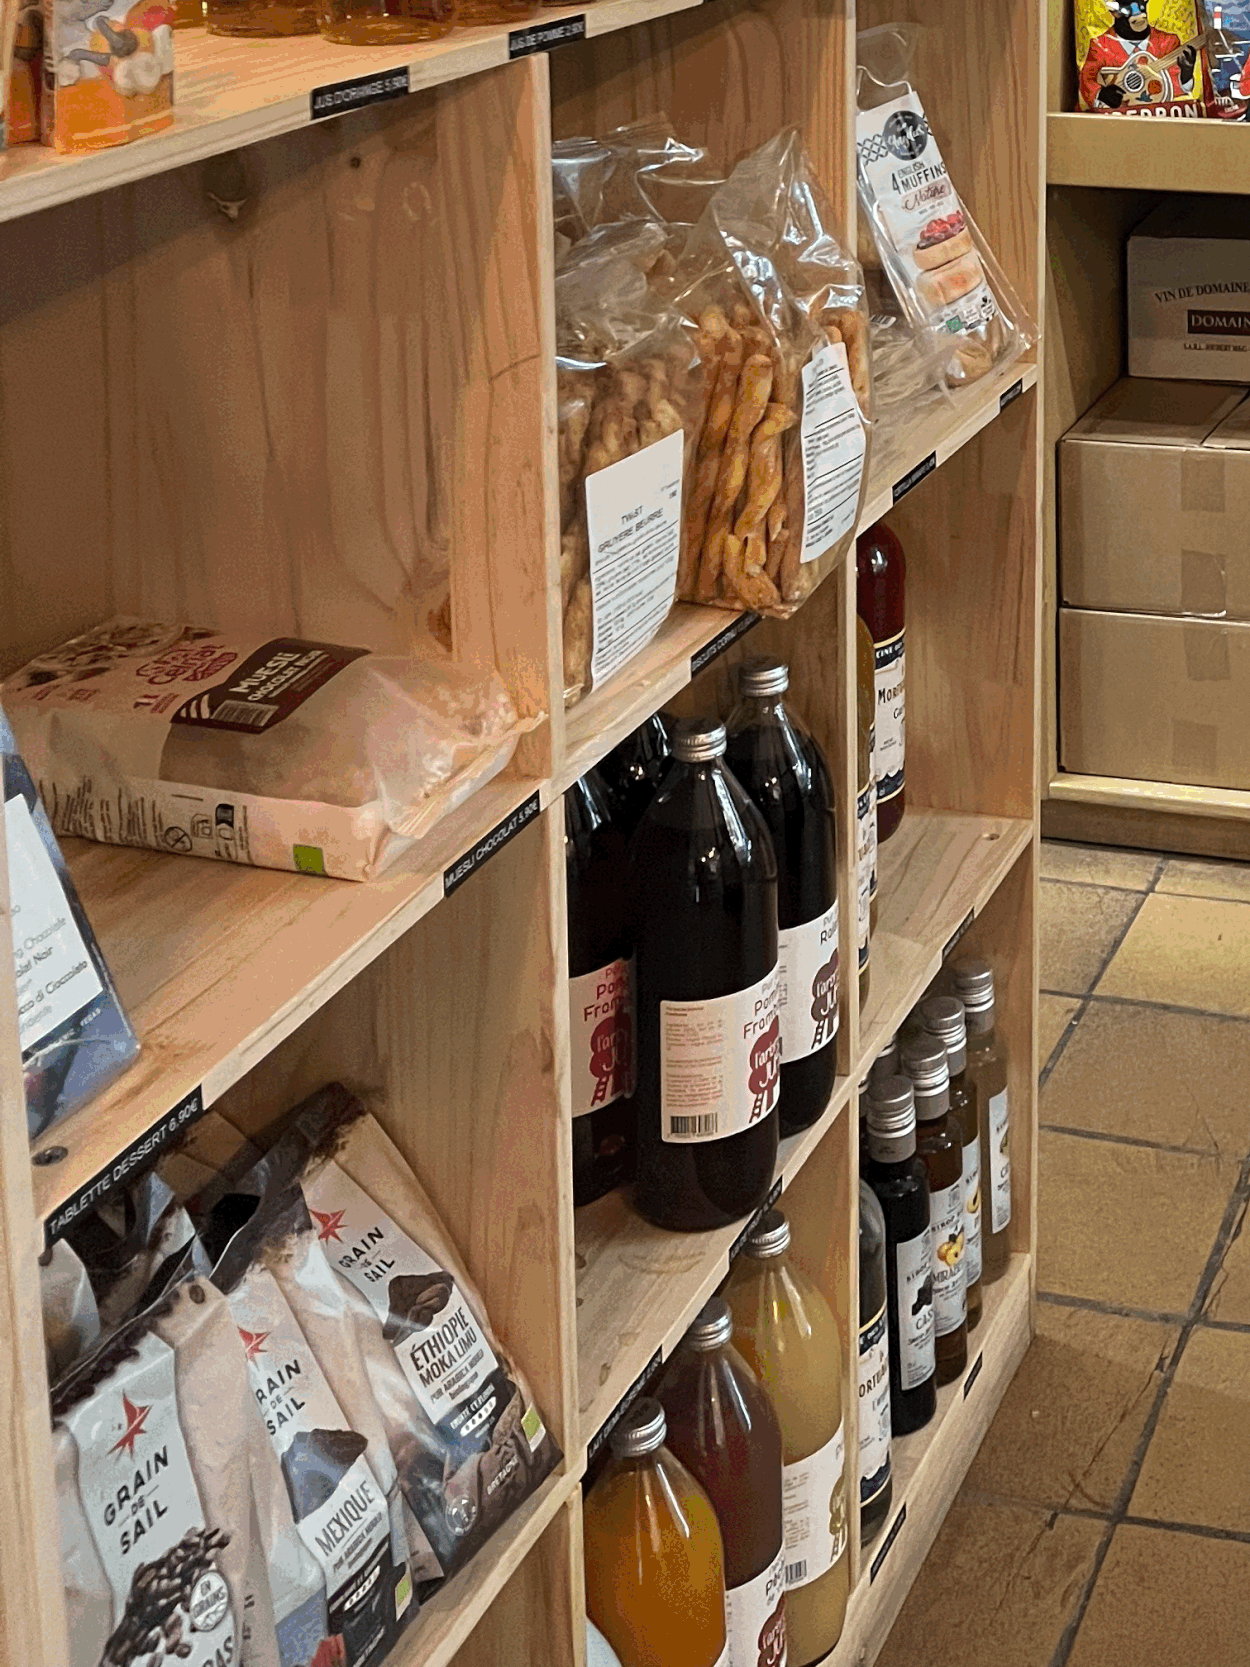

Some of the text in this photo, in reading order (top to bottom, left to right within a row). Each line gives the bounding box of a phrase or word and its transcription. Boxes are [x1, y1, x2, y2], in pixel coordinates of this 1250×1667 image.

[900, 161, 947, 192] MUFFINS
[1154, 290, 1177, 305] VIN
[1178, 285, 1194, 298] DE
[1195, 281, 1250, 297] DOMAINE
[233, 651, 300, 694] MUESLI
[49, 1097, 198, 1235] TABLETTE DESSERT 6.90€
[340, 1226, 385, 1271] GRAIN
[365, 1257, 396, 1284] SAIL
[410, 1306, 470, 1370] ÉTHIOPIE
[418, 1353, 455, 1388] MOKA
[266, 1396, 305, 1436] SAIL
[103, 1445, 169, 1527] GRAIN
[130, 1497, 145, 1516] DE
[119, 1499, 169, 1555] SAIL
[315, 1480, 375, 1557] MEXIQUE
